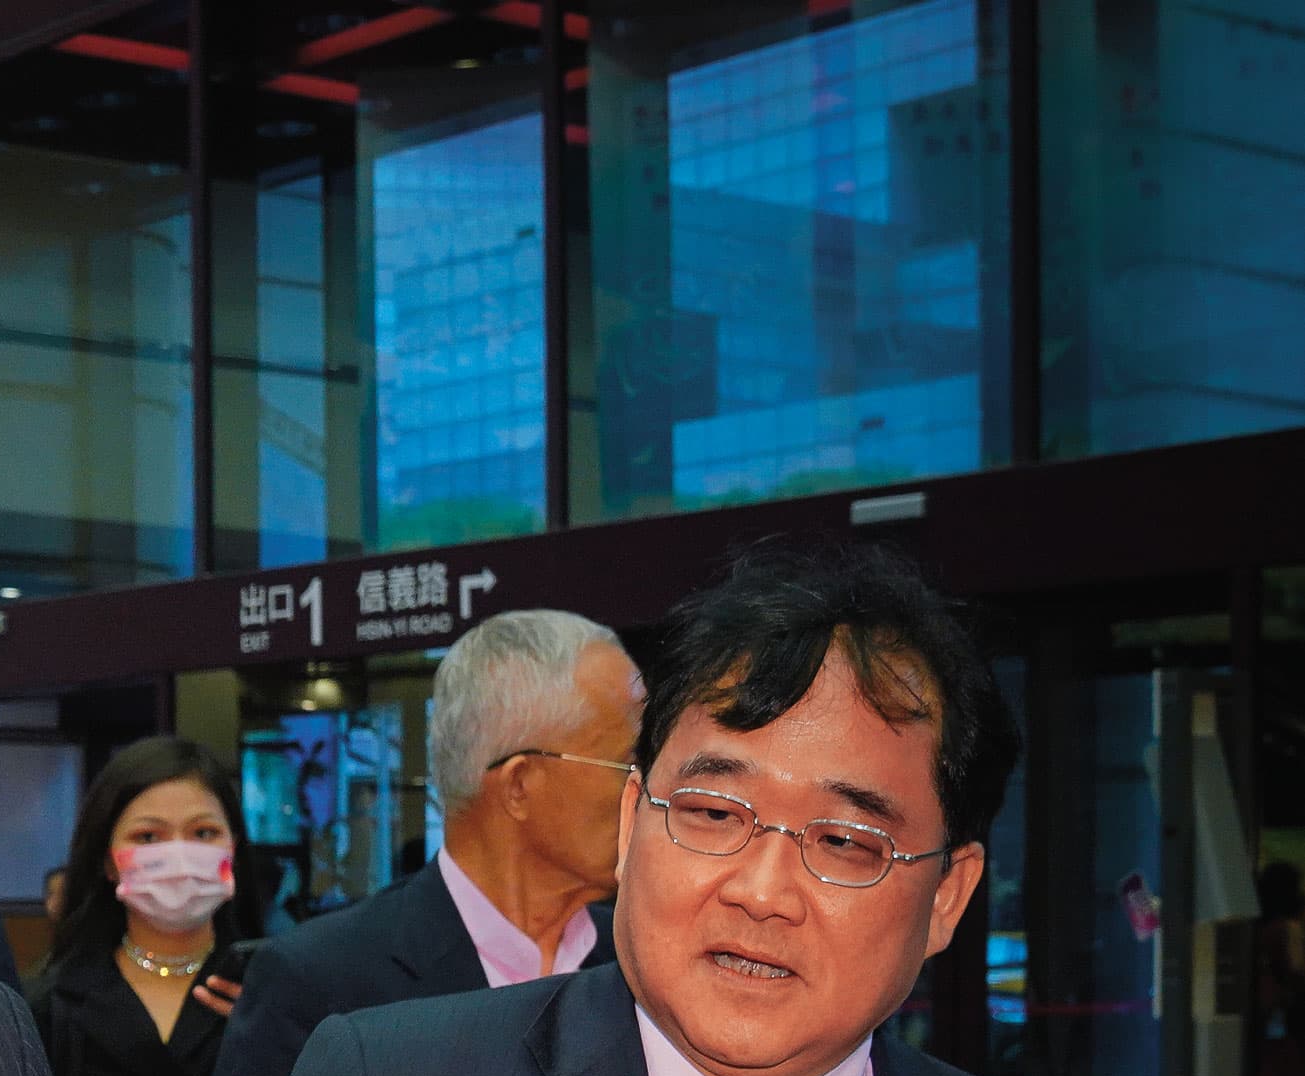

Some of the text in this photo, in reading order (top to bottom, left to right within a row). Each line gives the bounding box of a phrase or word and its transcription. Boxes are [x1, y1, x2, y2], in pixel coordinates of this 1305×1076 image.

[239, 576, 323, 647] 出口 1
[356, 561, 448, 615] 信義路
